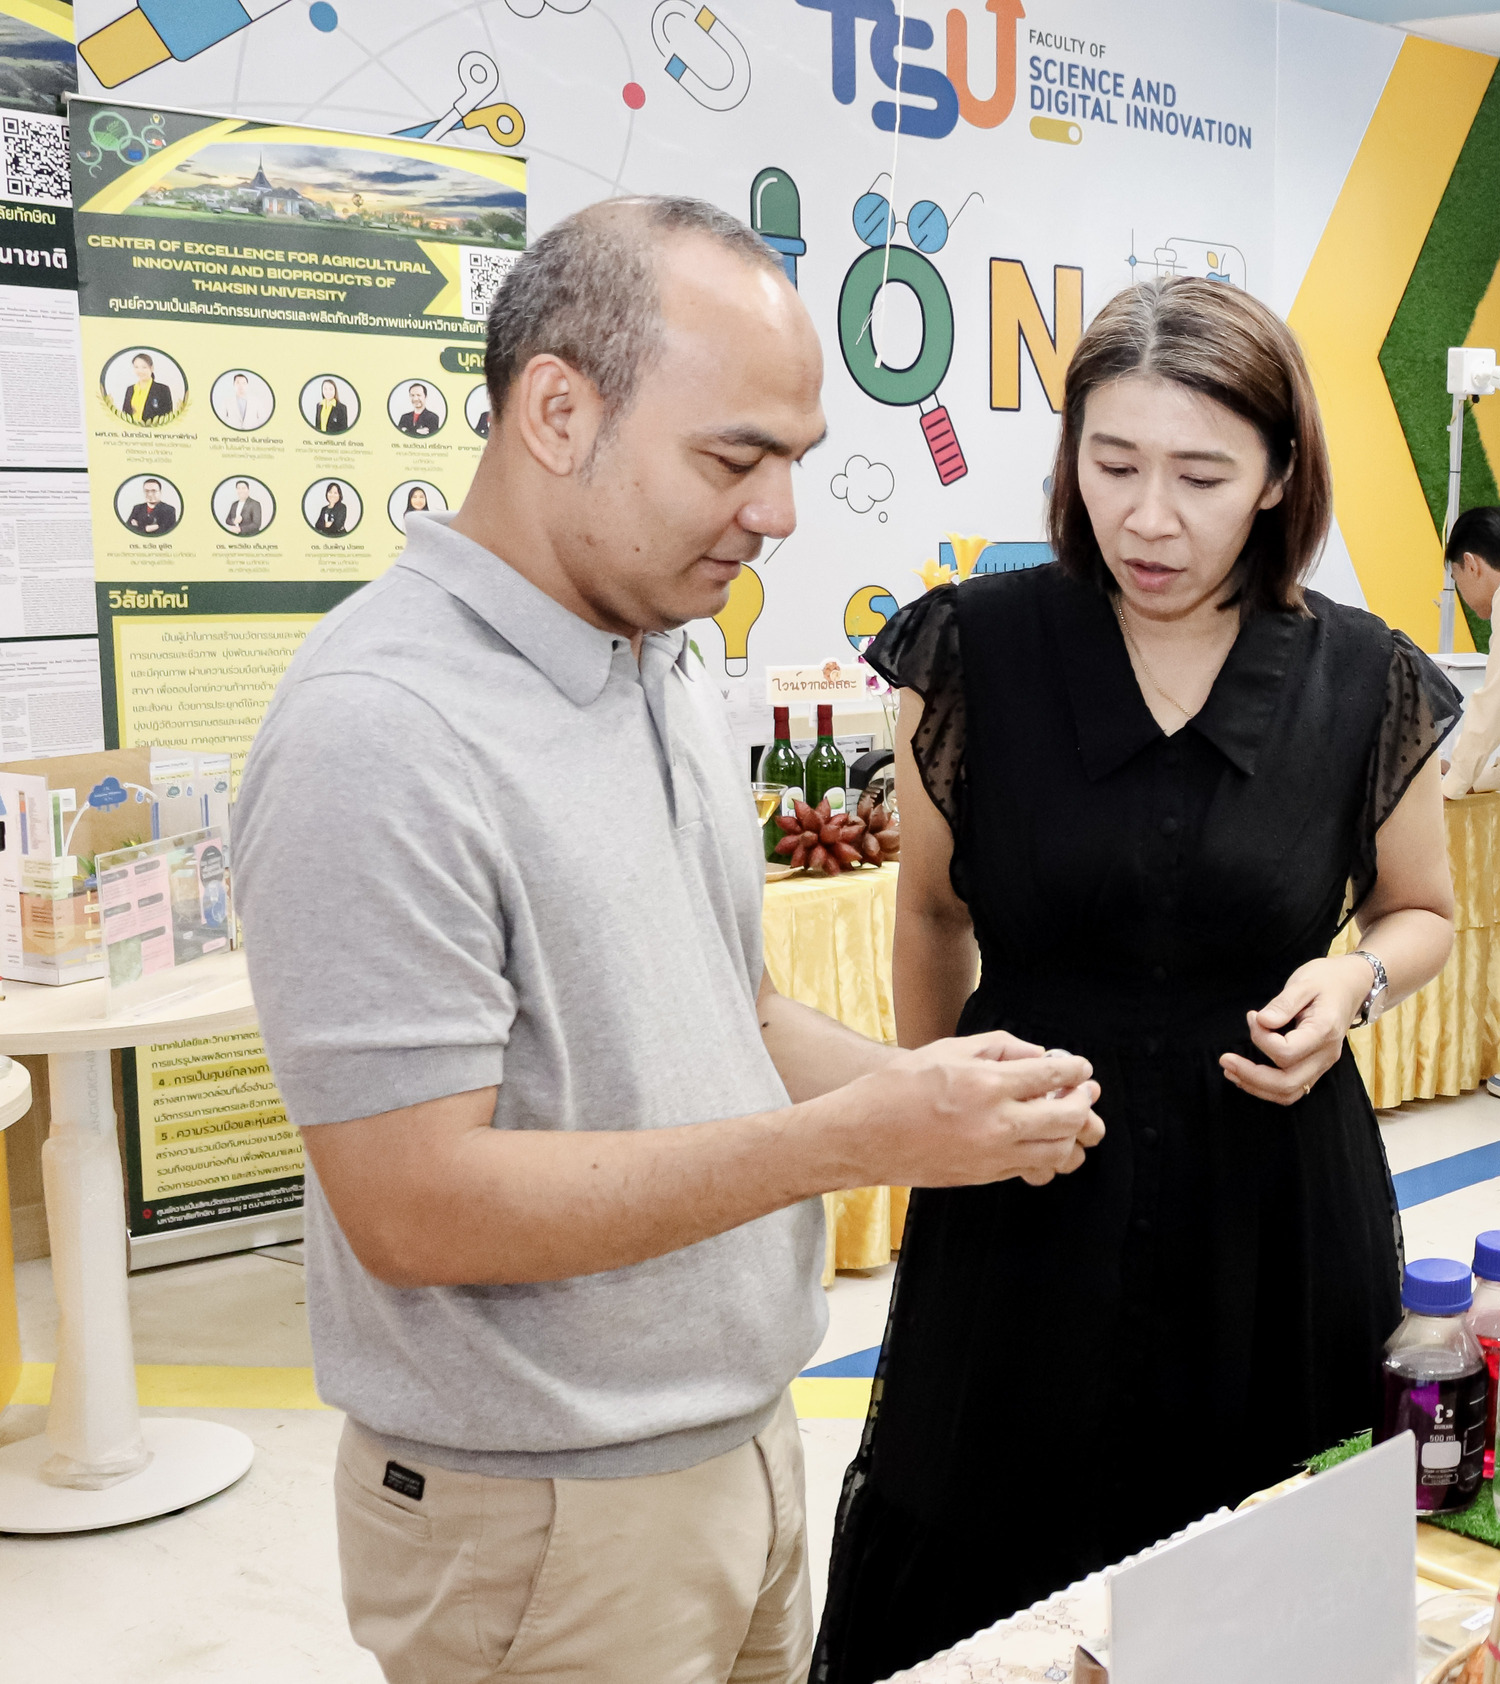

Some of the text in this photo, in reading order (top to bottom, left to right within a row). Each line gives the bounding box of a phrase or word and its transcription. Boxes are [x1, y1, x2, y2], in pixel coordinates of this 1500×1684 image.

[1029, 29, 1106, 58] FACULTY OF
[795, 0, 1027, 139] TSU
[1029, 55, 1176, 107] SCIENCE AND
[1030, 84, 1252, 150] DIGITAL INNOVATION
[87, 235, 432, 275] CENTER OF EXCELLENCE FOR AGRICULTURAL
[132, 256, 396, 288] INNOVATION AND BIOPRODUCTS OF
[192, 279, 347, 302] THAKSIN UNIVERSITY
[109, 296, 486, 334] ศูนย์ความเป็นเลิศนวัตกรรมเกษตรและผลิตภัณฑ์ชีวภาพแห่งมหาวิทยาลัยทั
[108, 585, 189, 609] วิสัยทัศน์
[189, 663, 287, 677] ผ่านความร่วมมือกับผู้เชี่
[178, 698, 269, 712] ด้วยการประยุกต์ใช้ควา
[191, 733, 254, 746] ภาคอุตสาหกรร
[174, 1064, 270, 1086] การเป็นศูนย์กลางกา
[1429, 1434, 1456, 1443] 500 ml
